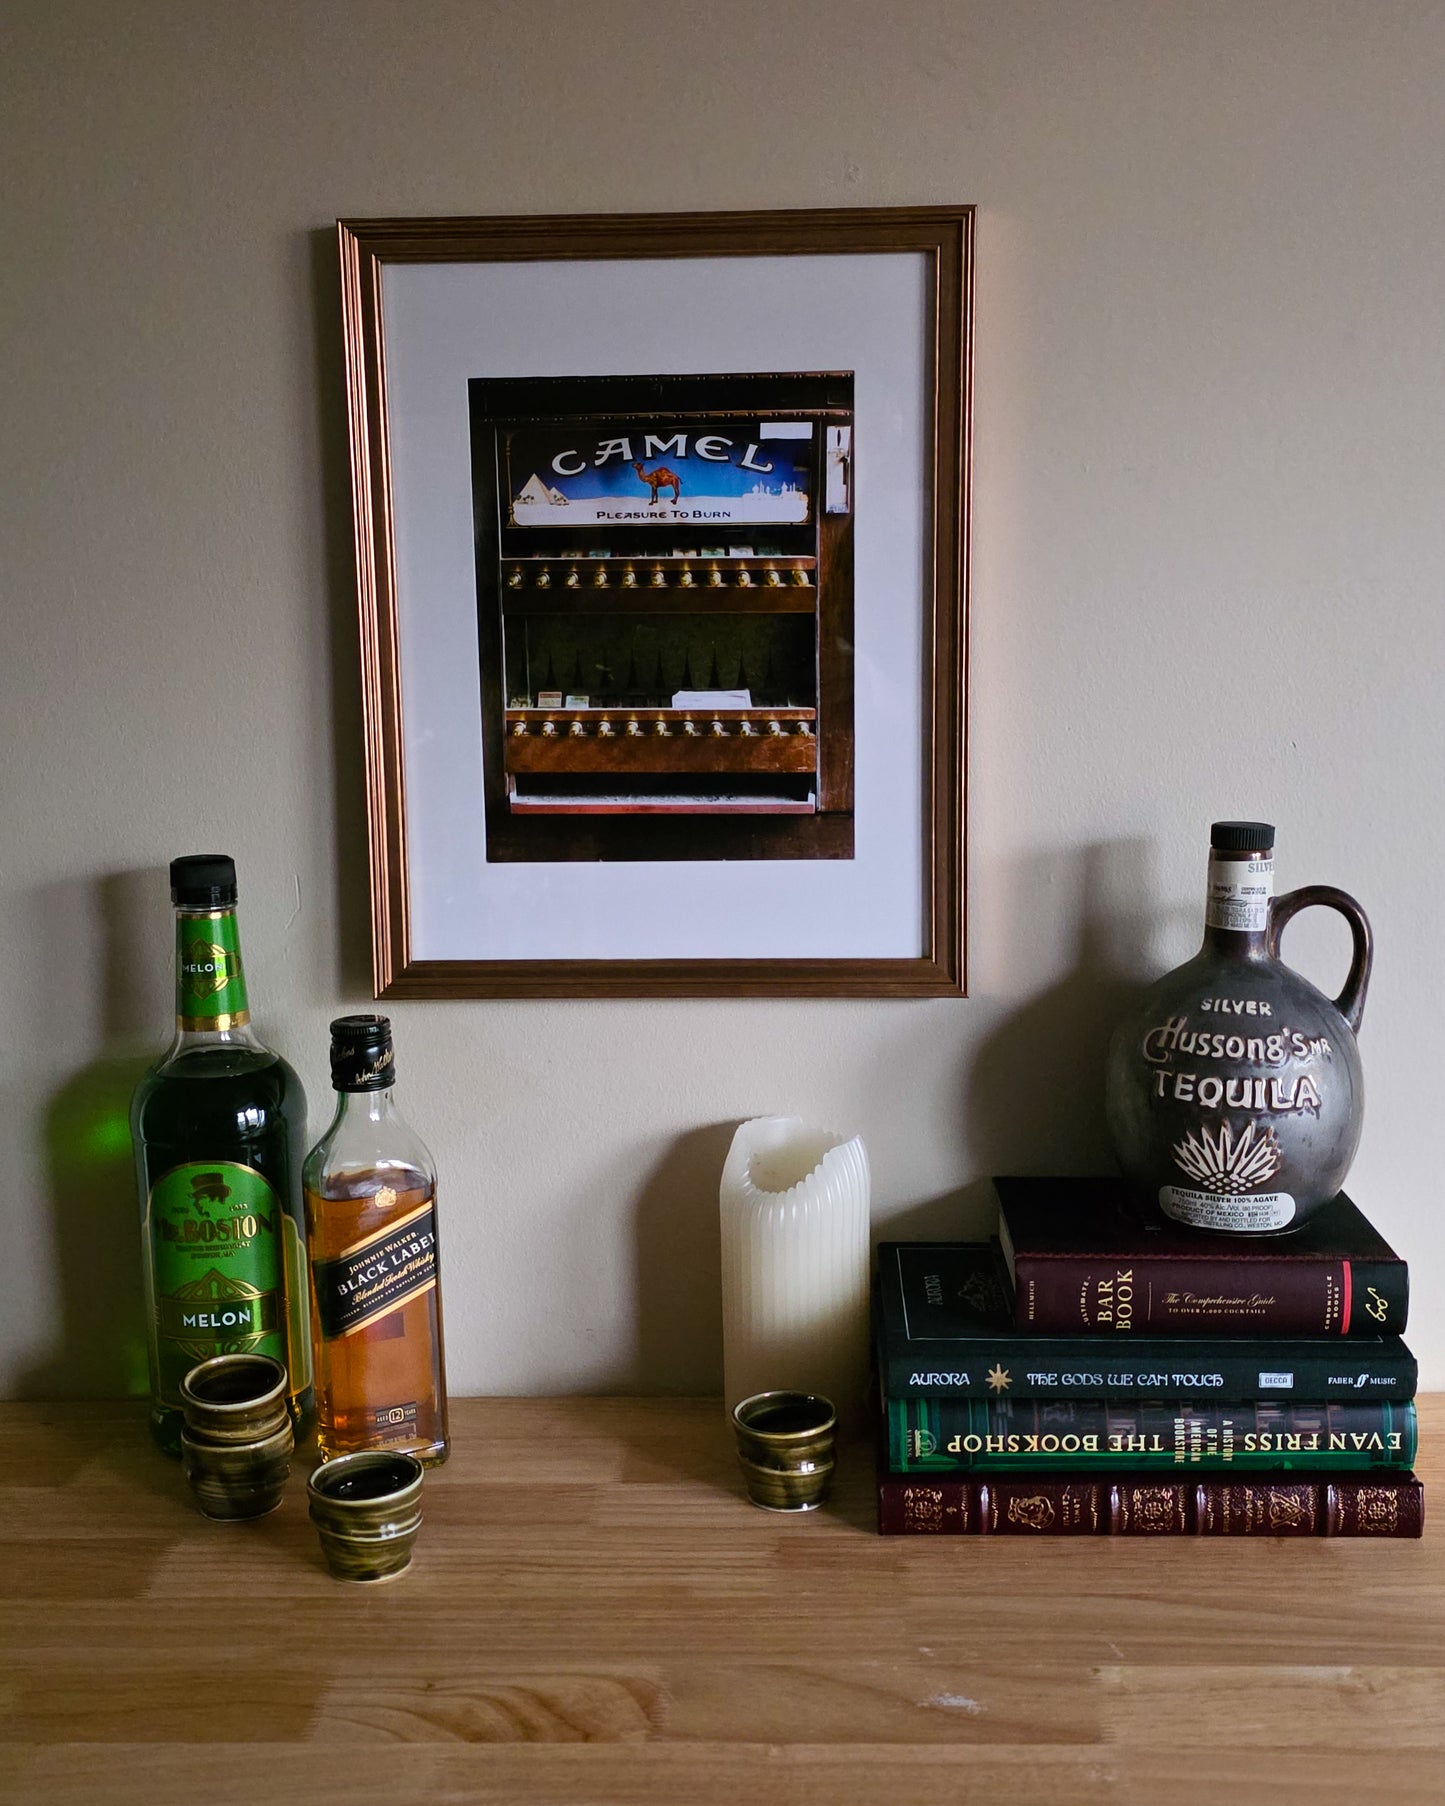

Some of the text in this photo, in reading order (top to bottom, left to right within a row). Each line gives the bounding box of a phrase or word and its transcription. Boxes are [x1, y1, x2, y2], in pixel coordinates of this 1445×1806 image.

[550, 434, 774, 475] CAMEL
[596, 510, 731, 520] PLEASURE TO BURN
[182, 963, 224, 974] MELON
[1201, 999, 1273, 1016] SILVER
[1154, 1069, 1321, 1109] TEQUILA
[1171, 1187, 1203, 1200] TEQUILA
[1205, 1195, 1232, 1203] SILVER
[1234, 1196, 1251, 1204] 100%
[1171, 1202, 1204, 1214] PRODUCT
[1216, 1210, 1245, 1218] MEXICO
[349, 1250, 385, 1275] JOHNNIE
[337, 1260, 389, 1296] BLACK
[352, 1283, 385, 1305] Blended
[407, 1252, 435, 1273] Whisky
[1097, 1279, 1114, 1322] BAR
[1116, 1269, 1133, 1330] BOOK
[1161, 1292, 1276, 1308] The Comprehensive Guide
[183, 1310, 251, 1328] MELON
[909, 1372, 970, 1386] AURORA
[1027, 1373, 1224, 1386] THE GODS WE CAN TOUCH
[1264, 1377, 1288, 1385] DECCA
[1328, 1377, 1354, 1385] FABER
[1370, 1377, 1397, 1385] MUSIC
[391, 1410, 401, 1420] 12
[947, 1434, 1164, 1453] THE BOOKSHOP
[1174, 1418, 1185, 1464] BOOKSTORE
[1190, 1421, 1201, 1462] AMERICAN
[1206, 1428, 1217, 1457] OF THE
[1222, 1419, 1234, 1462] A HISTORY
[1244, 1432, 1402, 1451] EVAN FRISS
